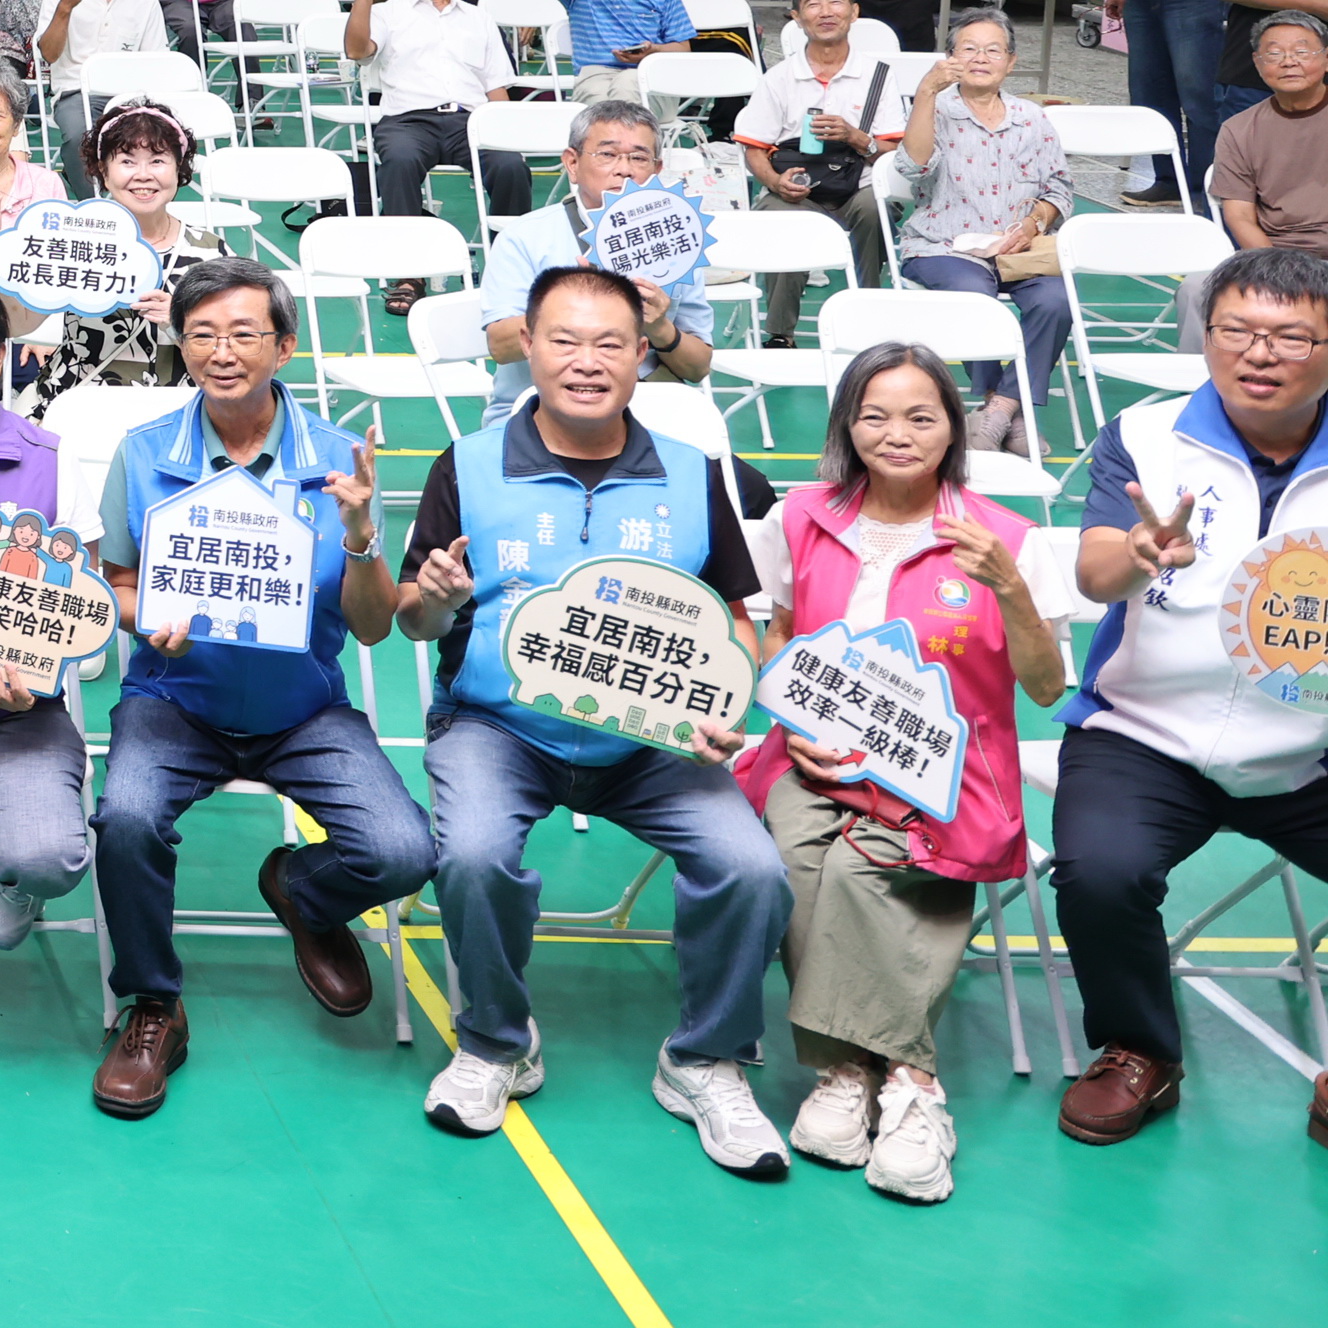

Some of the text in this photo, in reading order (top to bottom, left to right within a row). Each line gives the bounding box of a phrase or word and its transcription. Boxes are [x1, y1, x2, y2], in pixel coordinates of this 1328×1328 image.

[63, 216, 117, 232] 南投縣政府
[627, 198, 672, 218] 南投縣政府
[22, 235, 128, 267] 友善職場，
[604, 214, 692, 255] 宜居南投，
[611, 232, 700, 274] 陽光樂活！
[7, 261, 136, 294] 成長更有力！
[212, 509, 279, 529] 南投縣政府
[536, 512, 556, 546] 主任
[1194, 485, 1224, 557] 人事處
[167, 533, 293, 572] 宜居南投，
[150, 564, 304, 607] 家庭更和樂！
[625, 586, 702, 621] 南投縣政府
[1262, 593, 1328, 624] 心靈
[560, 605, 711, 670] 宜居南投，
[517, 631, 734, 719] 幸福感百分百！
[865, 660, 926, 702] 南投縣政府
[791, 648, 954, 759] 健康友善職場
[784, 678, 931, 779] 效率一級棒！
